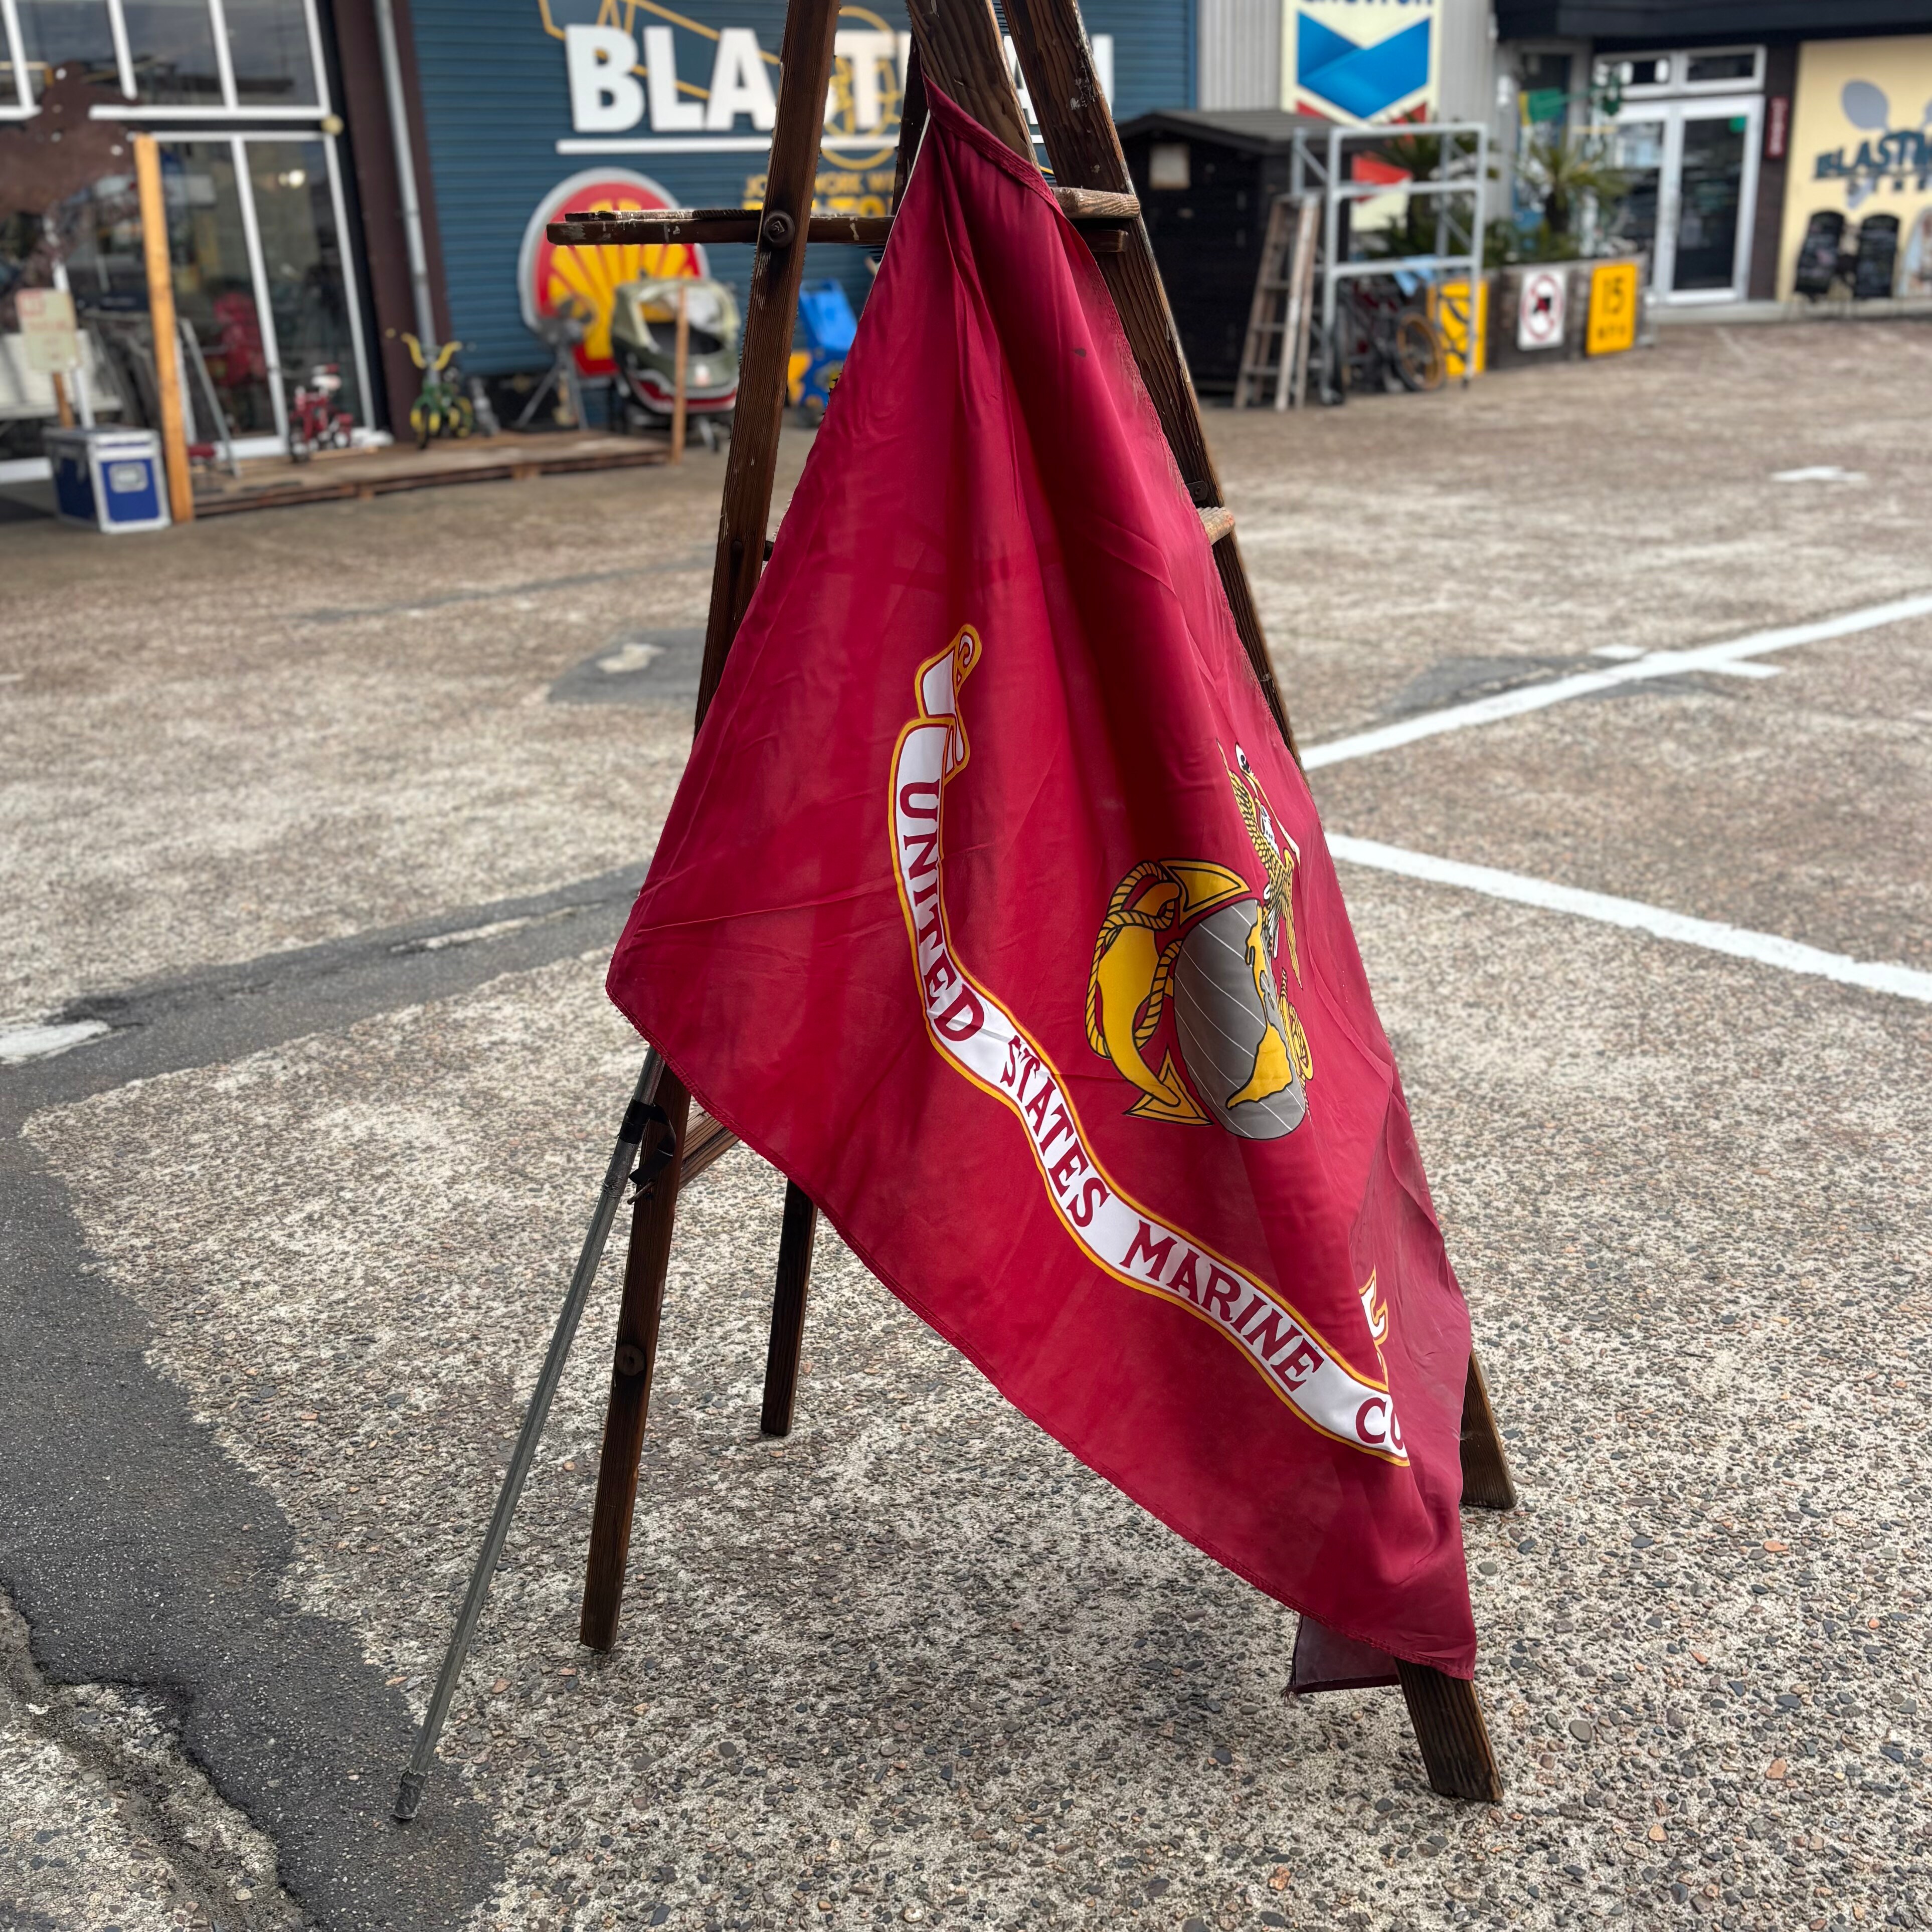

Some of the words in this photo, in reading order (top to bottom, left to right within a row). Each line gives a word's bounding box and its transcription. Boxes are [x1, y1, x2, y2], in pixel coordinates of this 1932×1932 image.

[900, 779, 984, 1041] UNITED
[1000, 1035, 1111, 1227] STATES
[1119, 1220, 1325, 1392] MARINE
